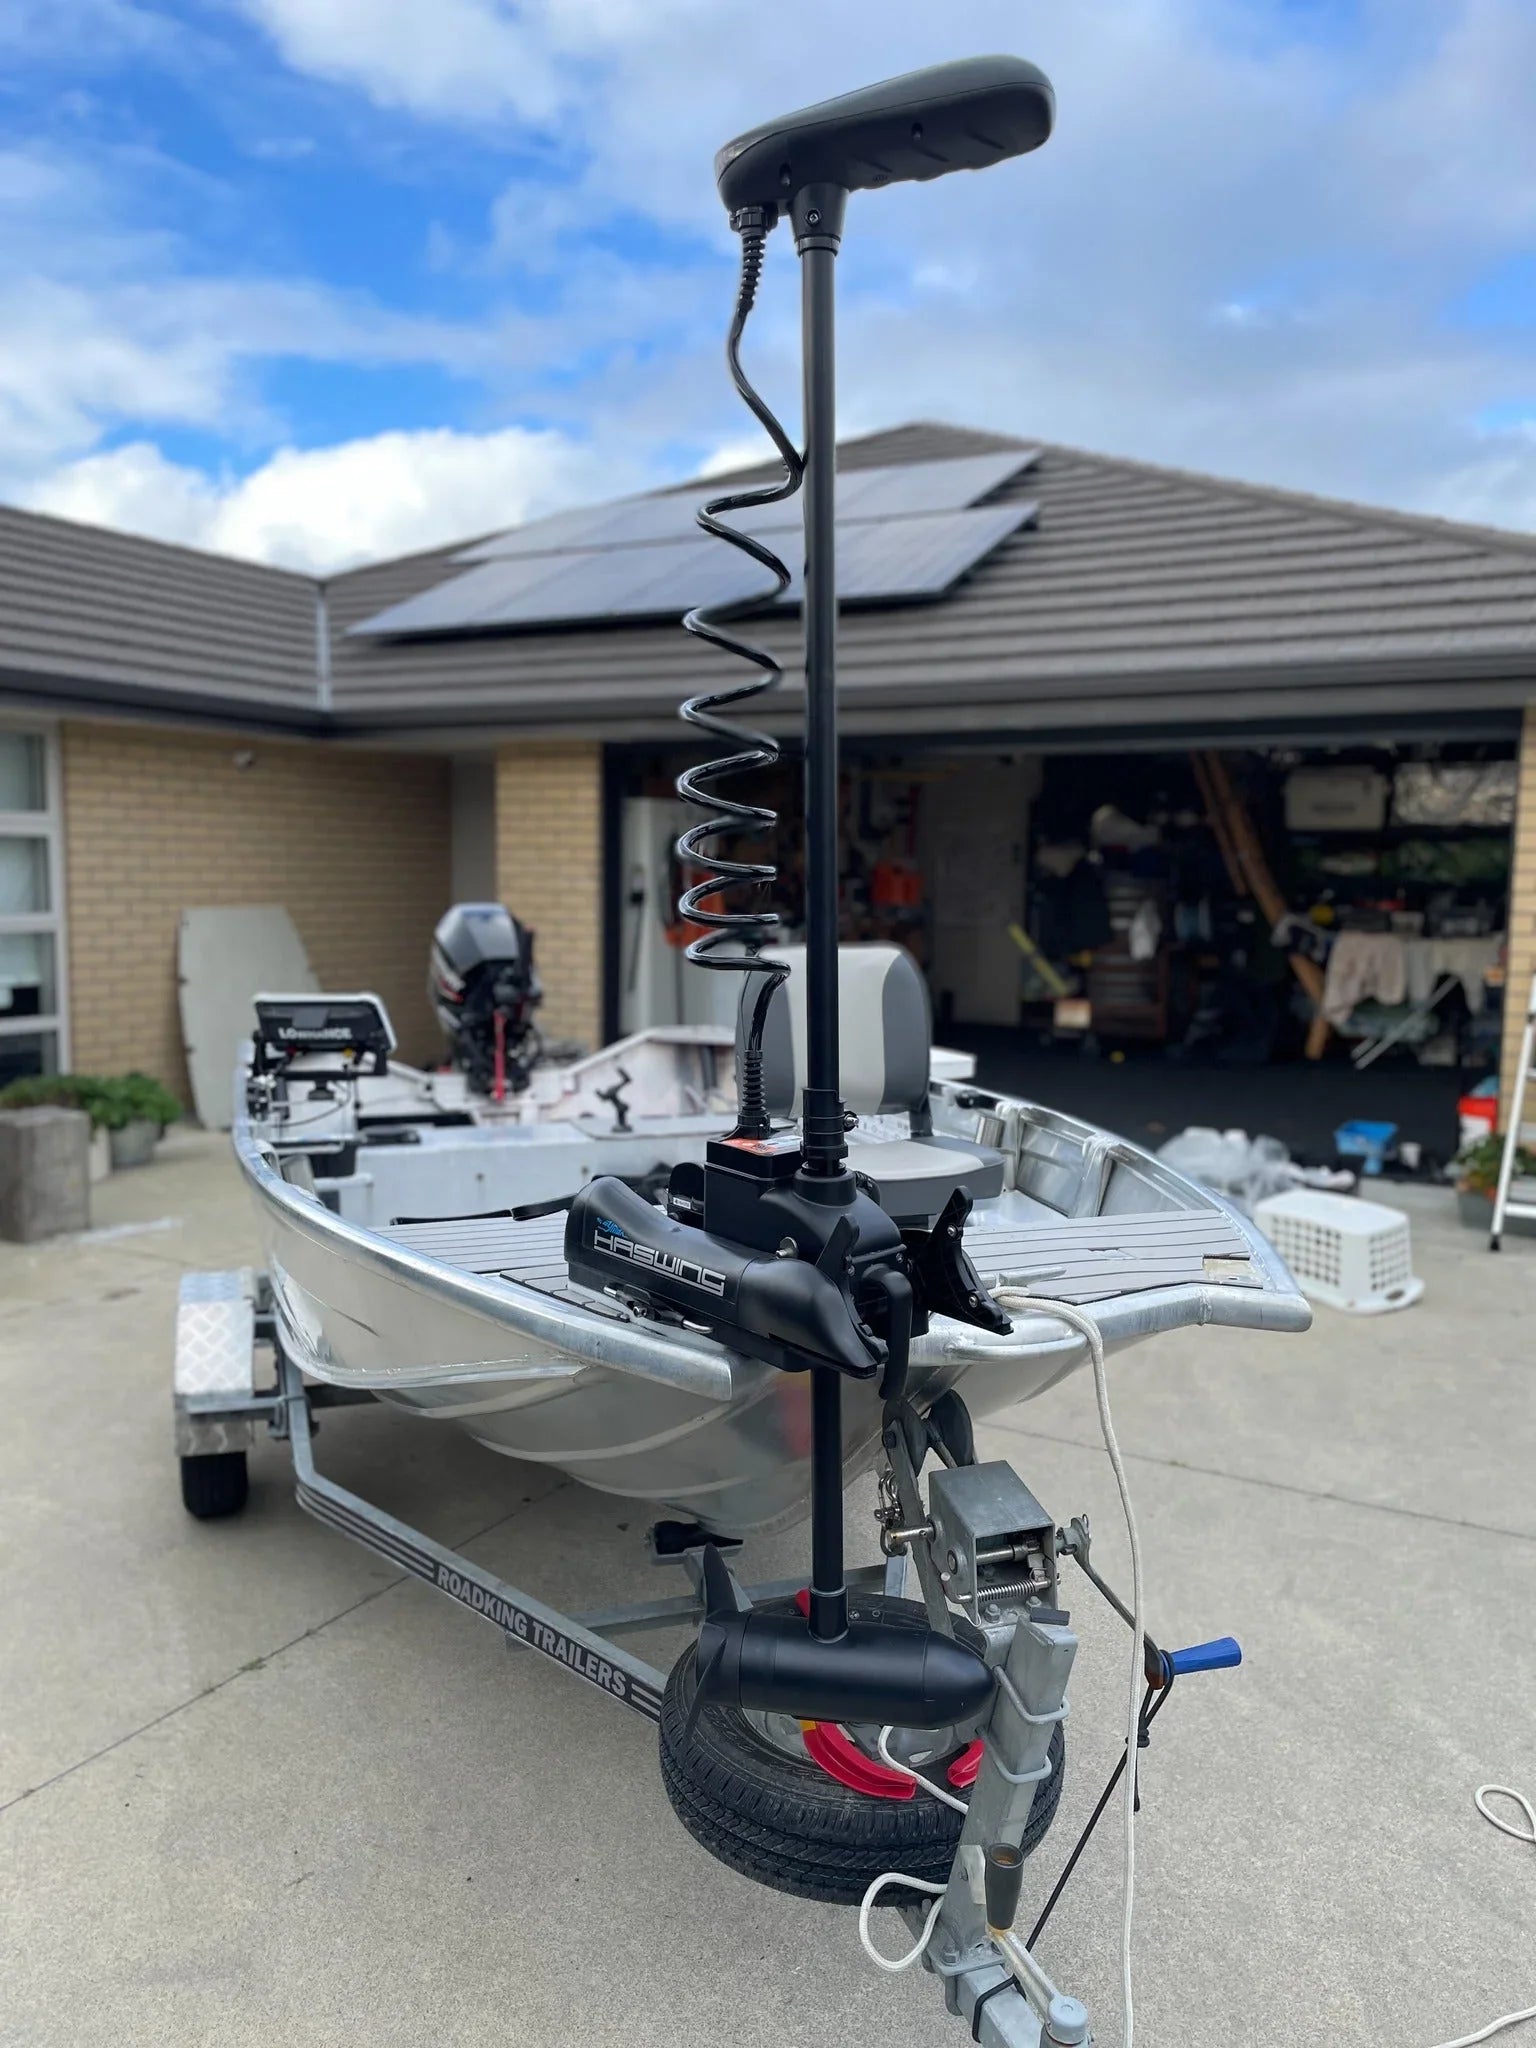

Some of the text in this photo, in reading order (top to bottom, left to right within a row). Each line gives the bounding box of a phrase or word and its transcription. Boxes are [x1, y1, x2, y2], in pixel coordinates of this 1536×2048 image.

[594, 1229, 726, 1296] HASWING
[438, 1565, 626, 1696] ROADKING TRAILERS
